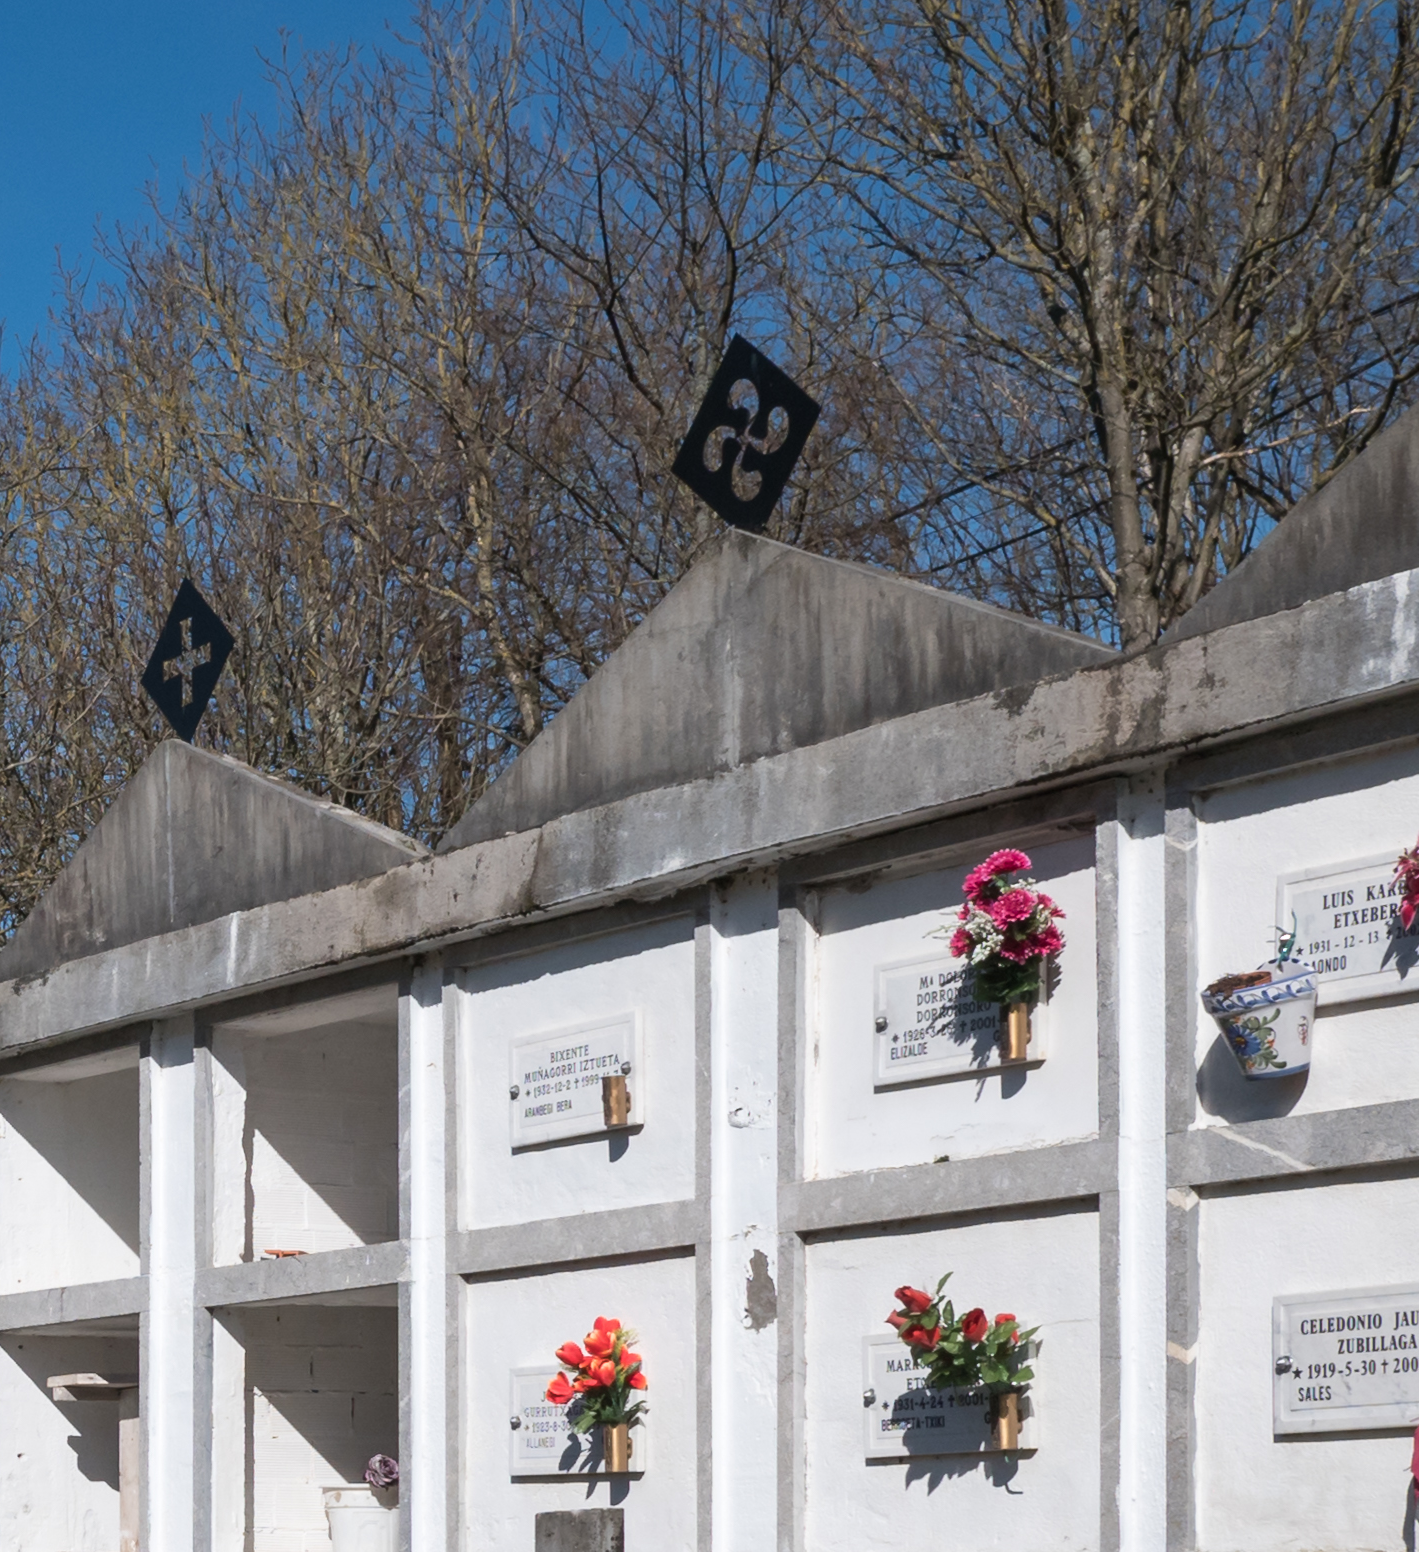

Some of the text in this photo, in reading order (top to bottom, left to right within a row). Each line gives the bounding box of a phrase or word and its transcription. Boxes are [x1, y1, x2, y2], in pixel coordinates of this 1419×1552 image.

[1323, 889, 1354, 910] LUIS
[1334, 902, 1400, 929] ETXEBER
[1309, 939, 1331, 955] 1931
[1344, 935, 1355, 949] 12
[1368, 930, 1379, 944] 13
[916, 985, 976, 1006] DORRONSO
[550, 1044, 589, 1063] BIXENTE
[890, 1042, 928, 1060] ELIZALDE
[524, 1054, 620, 1084] MUÑAGORRI IZTUETA
[1300, 1310, 1419, 1335] CELEDONIO JAU
[1337, 1333, 1417, 1354] ZUBILLAGA
[1307, 1356, 1419, 1380] 1919-5-30 200
[1298, 1386, 1332, 1402] SALES
